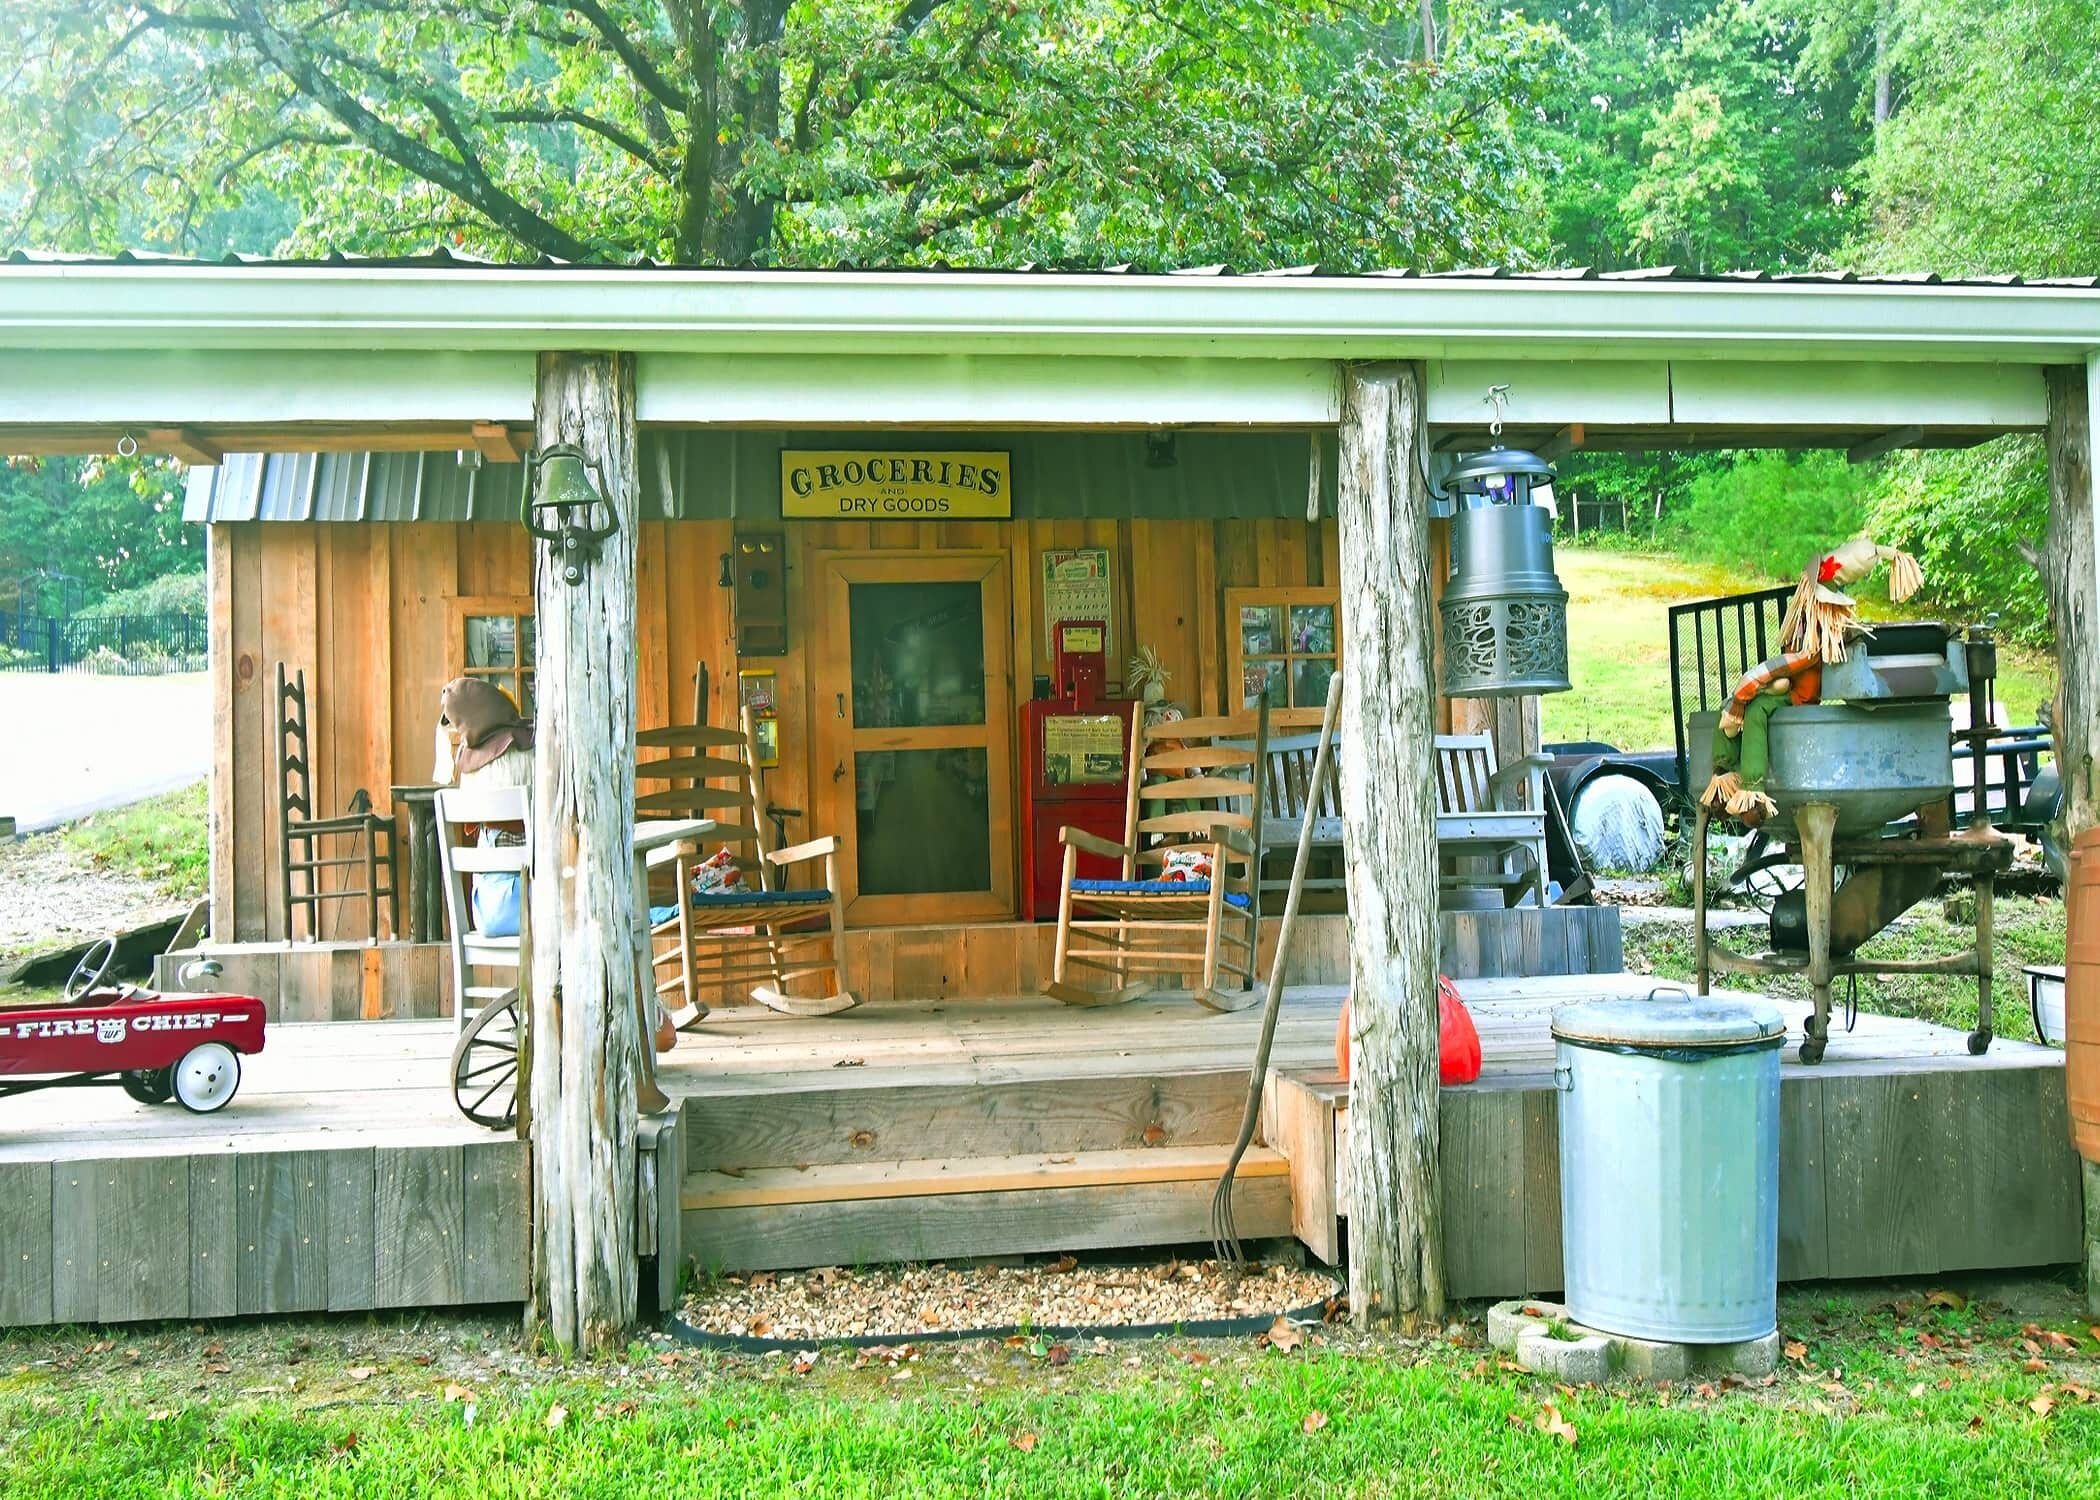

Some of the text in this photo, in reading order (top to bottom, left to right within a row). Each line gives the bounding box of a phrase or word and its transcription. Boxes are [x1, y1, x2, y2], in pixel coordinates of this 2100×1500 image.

[790, 458, 1000, 497] GROCERIES
[840, 498, 949, 512] DRY GOODS
[16, 1013, 220, 1039] FIRE CHIEF
